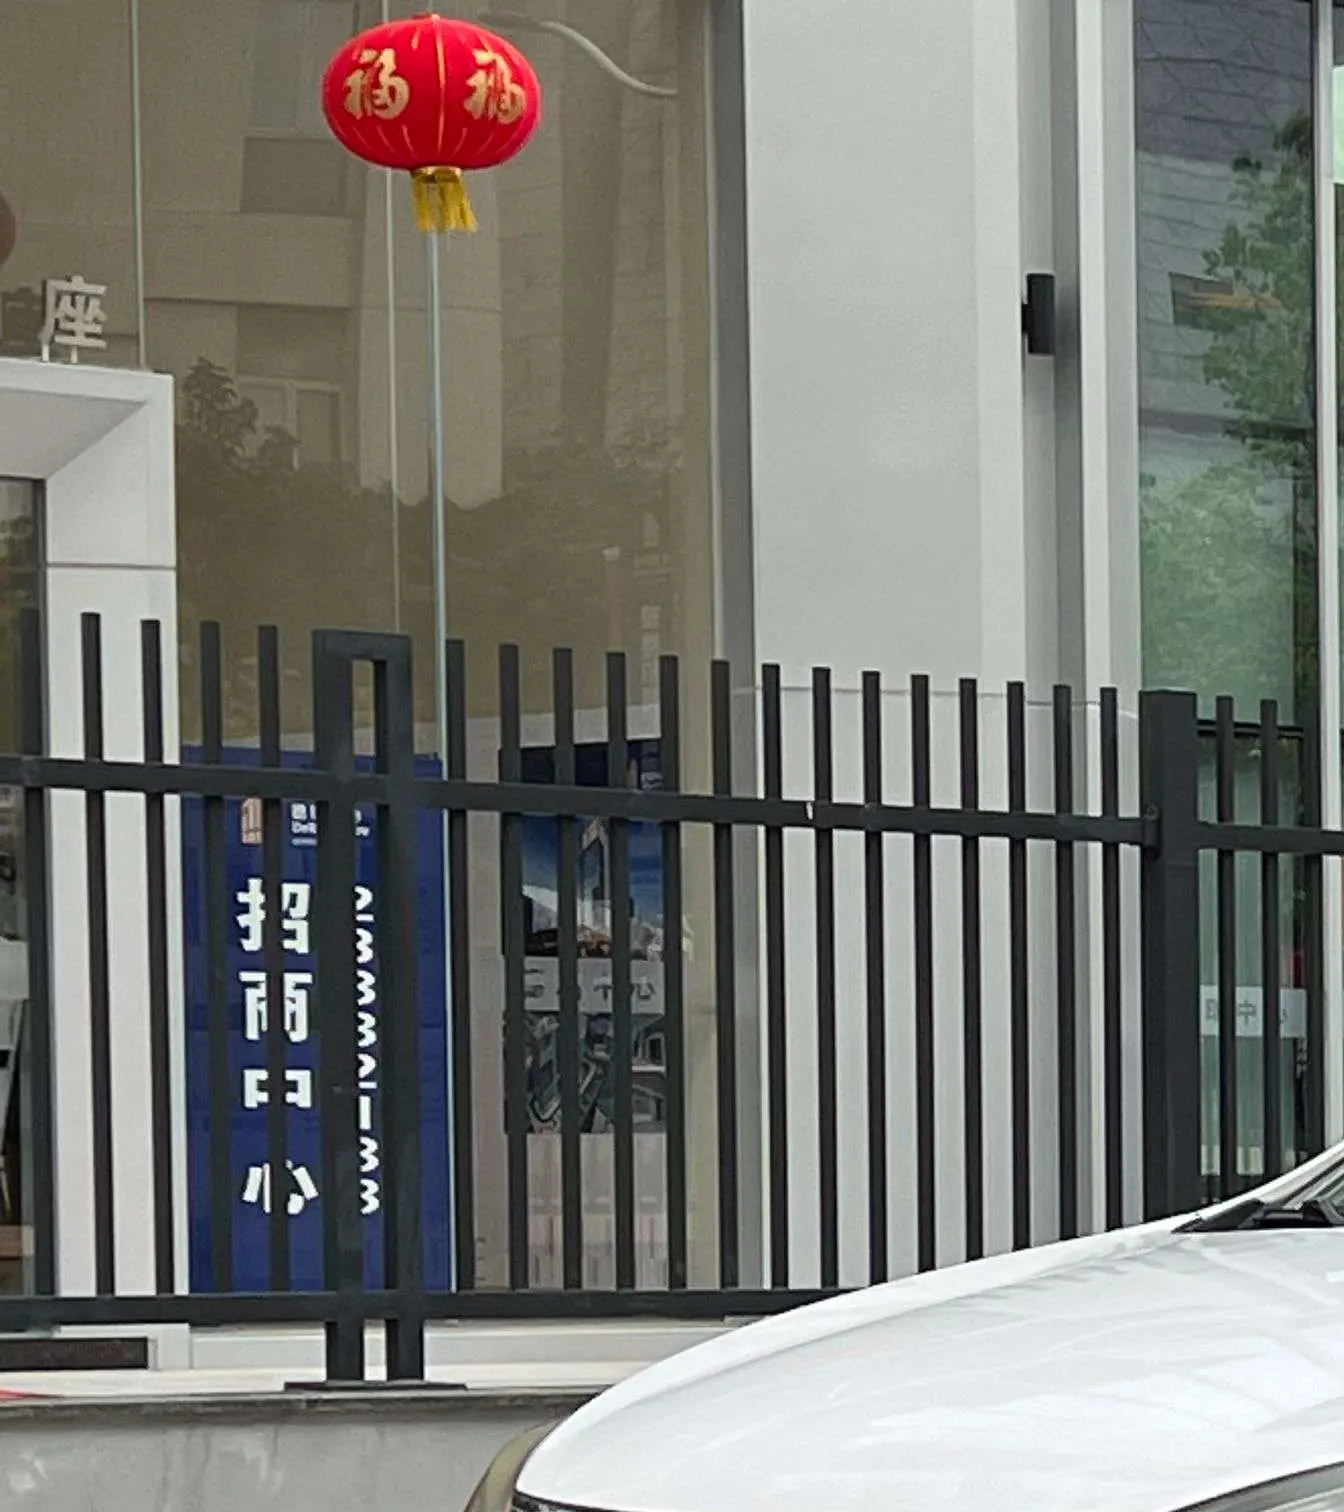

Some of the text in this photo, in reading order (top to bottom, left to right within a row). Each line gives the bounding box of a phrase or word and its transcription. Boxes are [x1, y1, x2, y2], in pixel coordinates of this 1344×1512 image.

[343, 48, 526, 124] 福 福
[36, 276, 107, 349] 座
